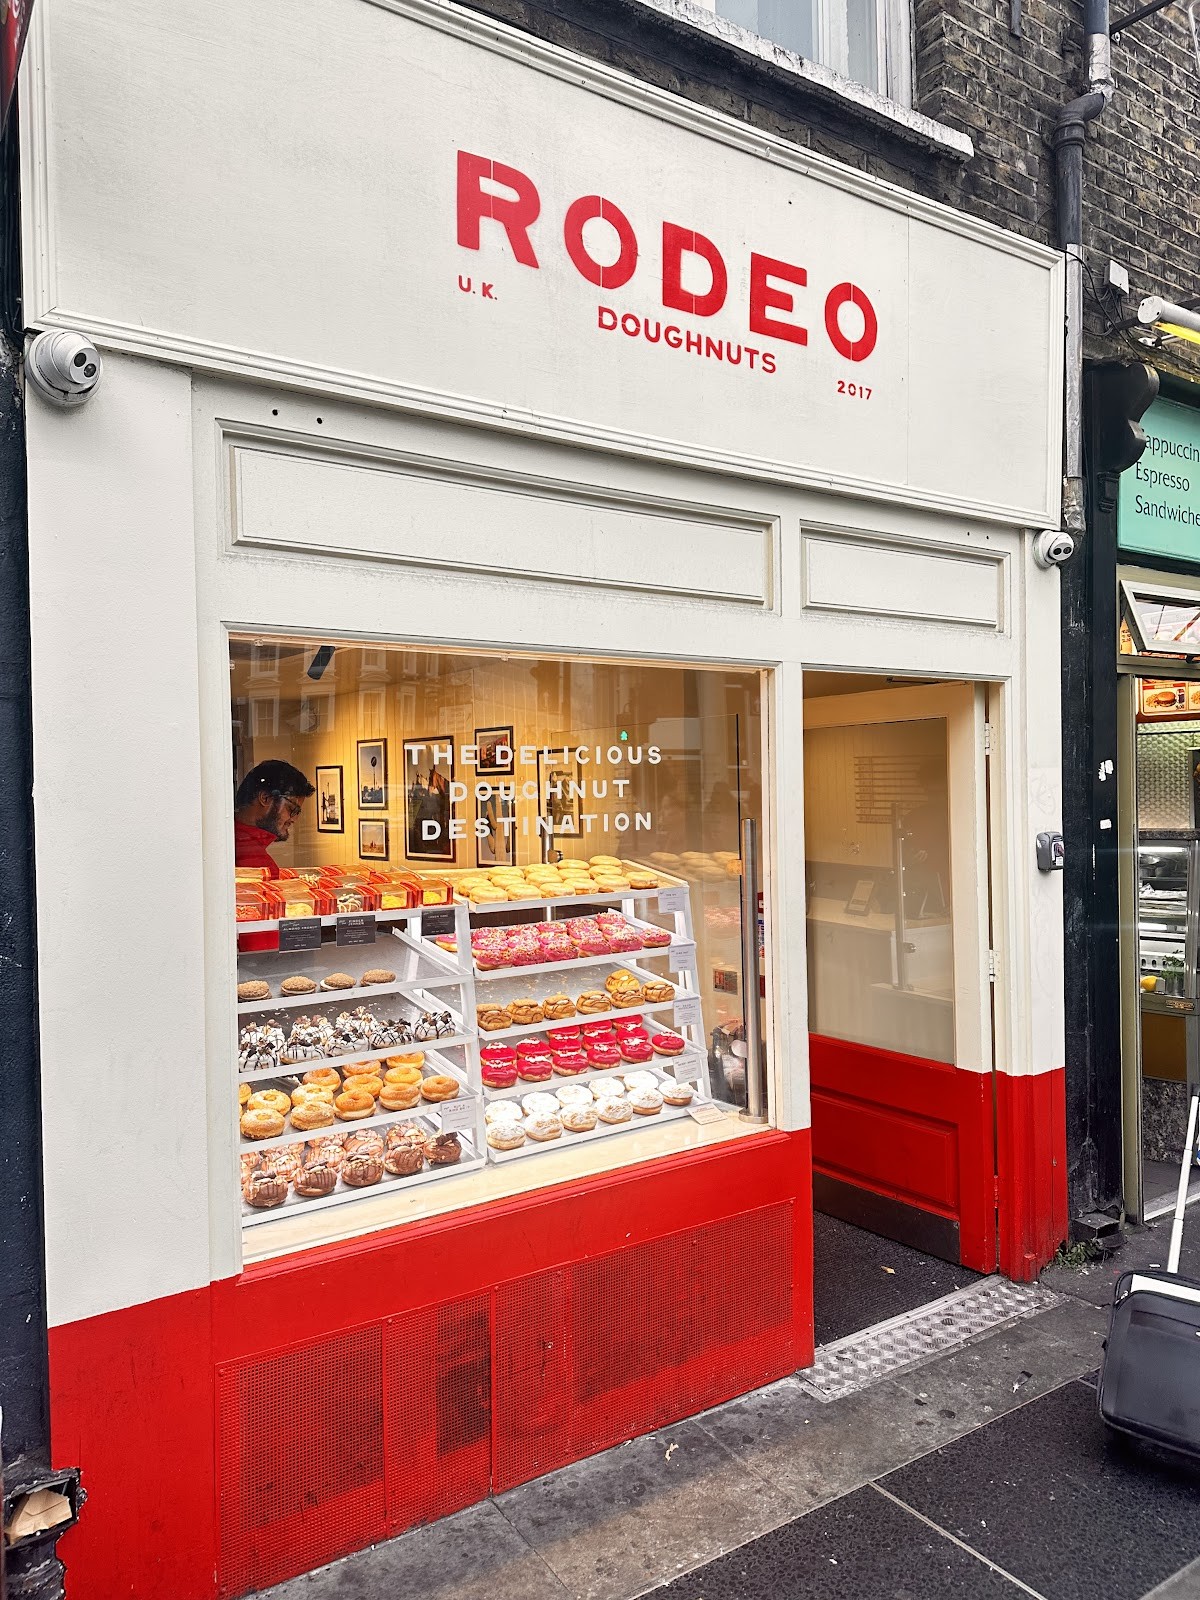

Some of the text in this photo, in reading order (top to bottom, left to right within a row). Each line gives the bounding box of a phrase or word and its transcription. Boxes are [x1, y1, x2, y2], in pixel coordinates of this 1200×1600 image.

[457, 149, 878, 362] RODEO
[597, 305, 777, 374] DOUGHNUTS
[836, 379, 873, 401] 2017
[1142, 428, 1200, 463] appuccin
[1136, 461, 1190, 492] Espresso
[404, 744, 662, 766] THE DELICIOUS
[421, 811, 652, 841] DESTINATION
